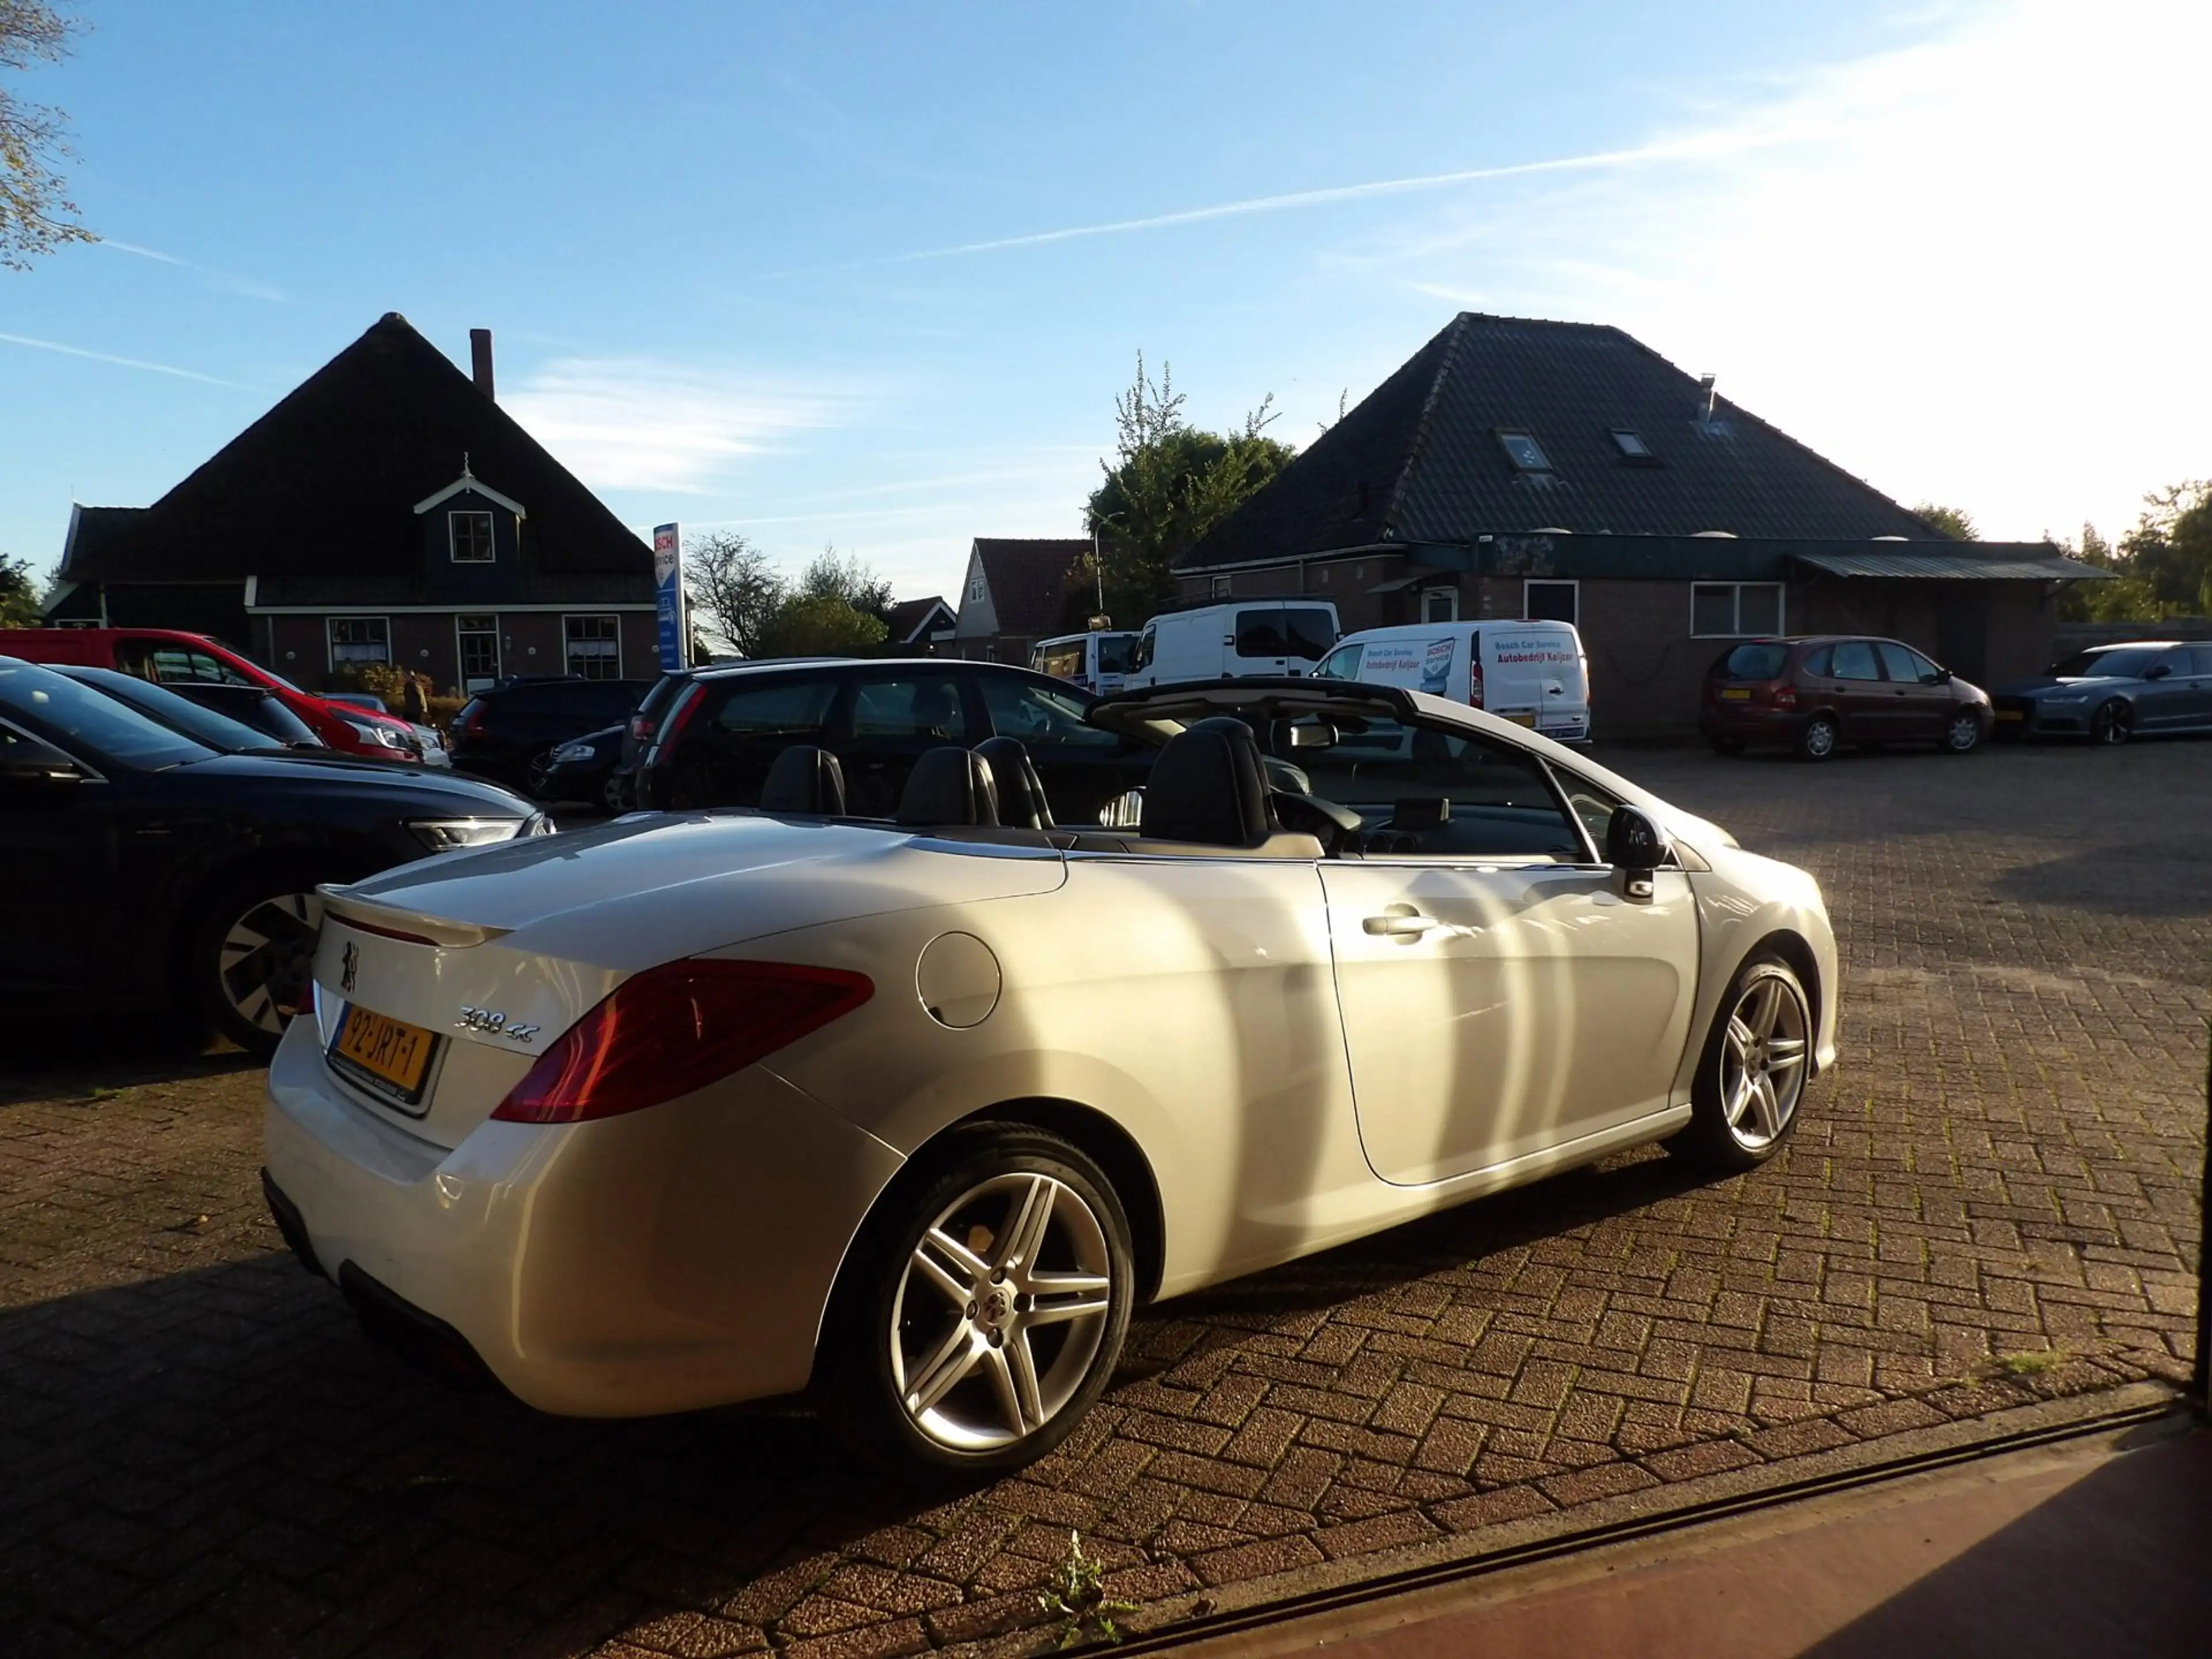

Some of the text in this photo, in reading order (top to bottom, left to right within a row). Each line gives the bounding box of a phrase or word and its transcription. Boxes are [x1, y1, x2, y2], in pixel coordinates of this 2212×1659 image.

[1495, 641, 1560, 650] Bosch Car Service
[1498, 652, 1573, 664] Autobedrijf Keijzer
[453, 1006, 505, 1034] 308
[347, 1010, 419, 1077] 92-JRT-1
